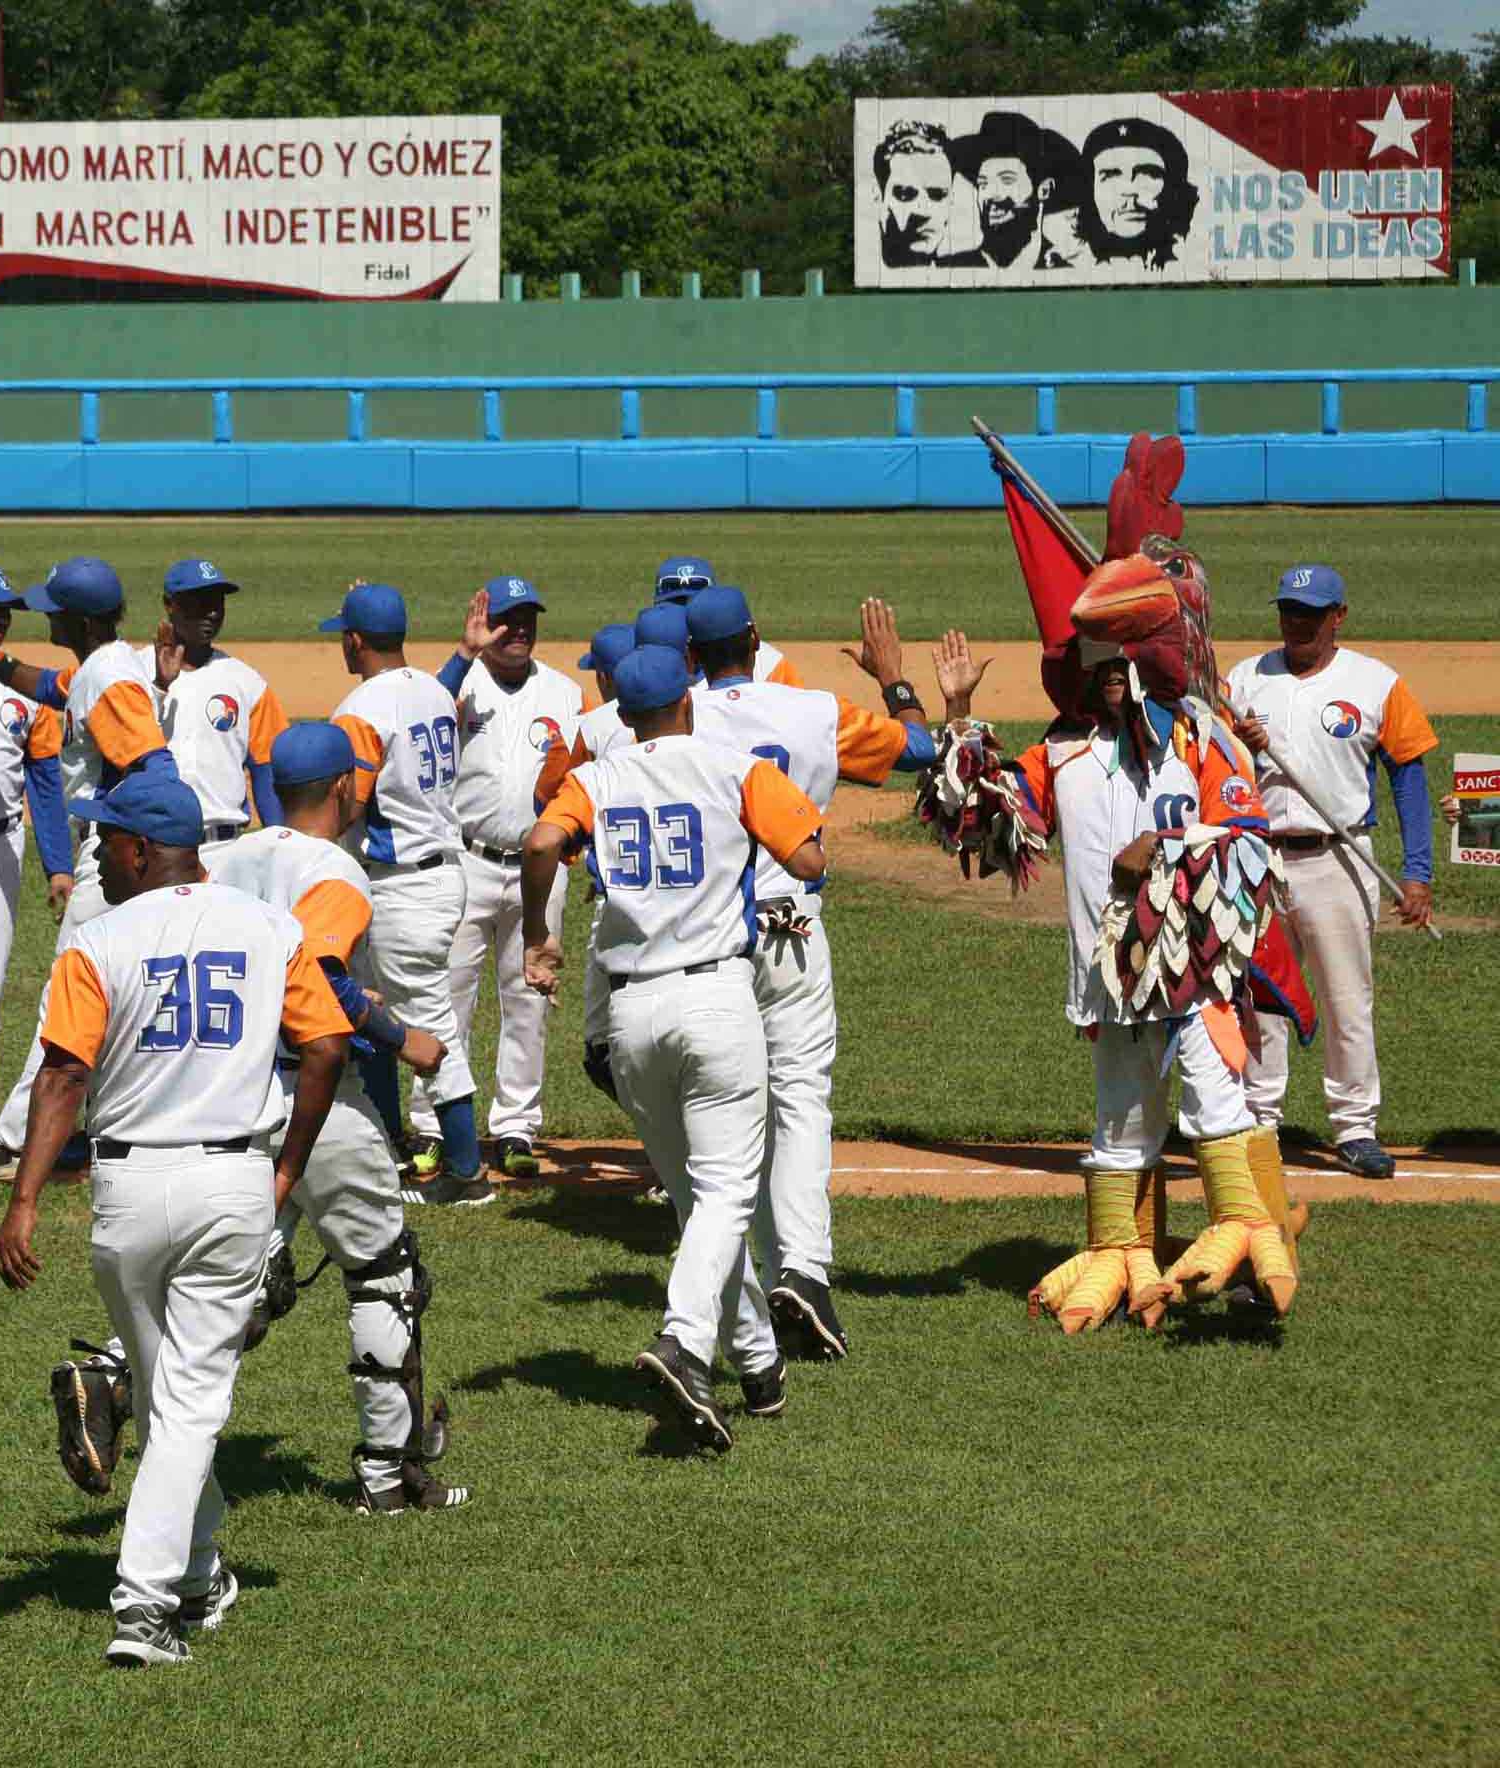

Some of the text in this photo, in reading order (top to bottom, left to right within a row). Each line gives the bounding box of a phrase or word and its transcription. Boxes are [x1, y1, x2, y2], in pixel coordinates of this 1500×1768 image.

[202, 141, 324, 180] MACEO
[334, 141, 357, 178] Y
[367, 131, 493, 177] GÓMEZ
[1212, 168, 1443, 214] NOS UNEN
[36, 209, 194, 246] MARCHA
[1212, 219, 1443, 261] LAS IDEAS
[364, 264, 410, 281] Fidel
[407, 715, 457, 794] 39
[603, 802, 705, 892] 33
[134, 948, 247, 1053] 36
